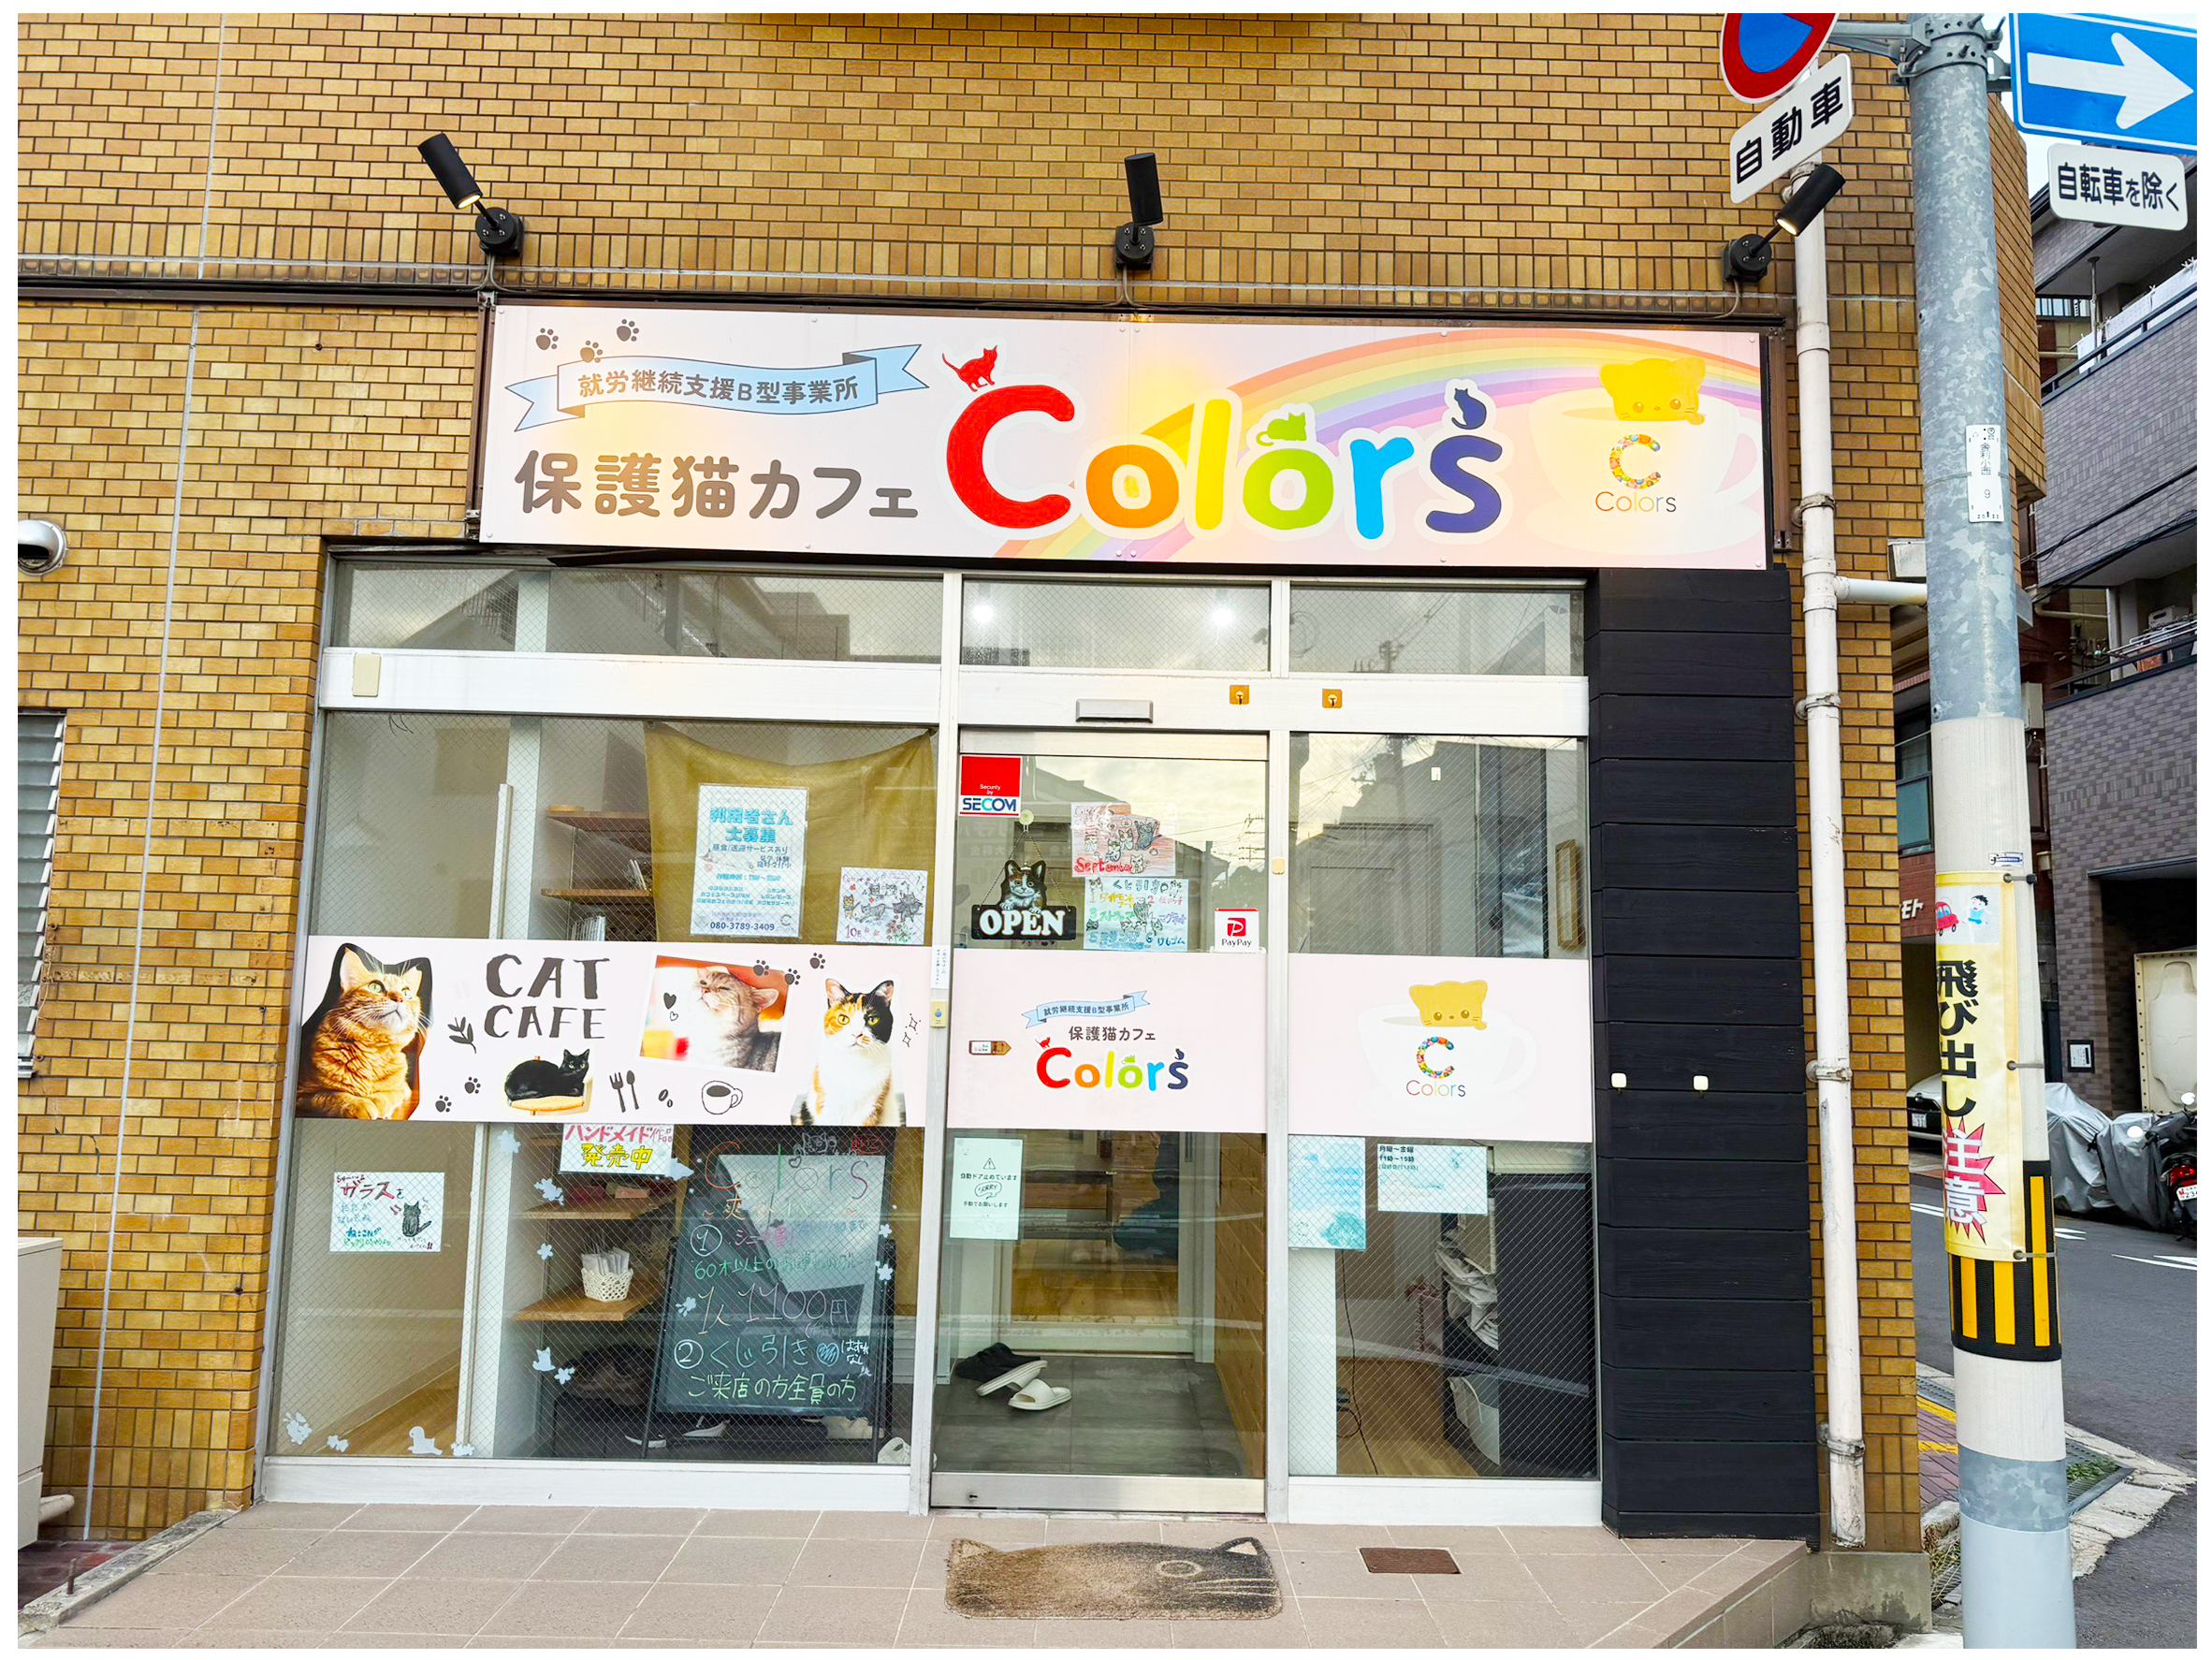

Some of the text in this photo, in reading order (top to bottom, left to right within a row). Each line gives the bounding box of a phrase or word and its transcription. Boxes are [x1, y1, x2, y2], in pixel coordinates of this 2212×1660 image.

[1736, 76, 1843, 185] 自動車
[2058, 161, 2180, 213] 自転車を除く
[577, 369, 860, 406] 就労継続支援B型事業所
[946, 384, 1503, 539] Colors
[514, 449, 919, 520] 保護猫カフェ
[1595, 491, 1677, 513] Colors
[962, 797, 1016, 812] SECOM
[979, 909, 1066, 937] OPEN
[1899, 898, 1924, 920] モト
[710, 922, 775, 931] 080-3789-3409
[1221, 939, 1252, 948] PayPay
[486, 953, 610, 999] CAT
[484, 1004, 606, 1041] CAFE
[1043, 1001, 1130, 1016] 就労継続支援B型事業所
[1069, 1026, 1157, 1041] 保護猫カフェ
[1036, 1047, 1189, 1091] Colors
[1405, 1079, 1466, 1098] Colors
[581, 1143, 653, 1171] 発売中
[341, 1179, 404, 1201] ガラスを
[960, 1172, 1017, 1181] 自動ドア止めています
[688, 1371, 857, 1405] ご来店の方全員の方
